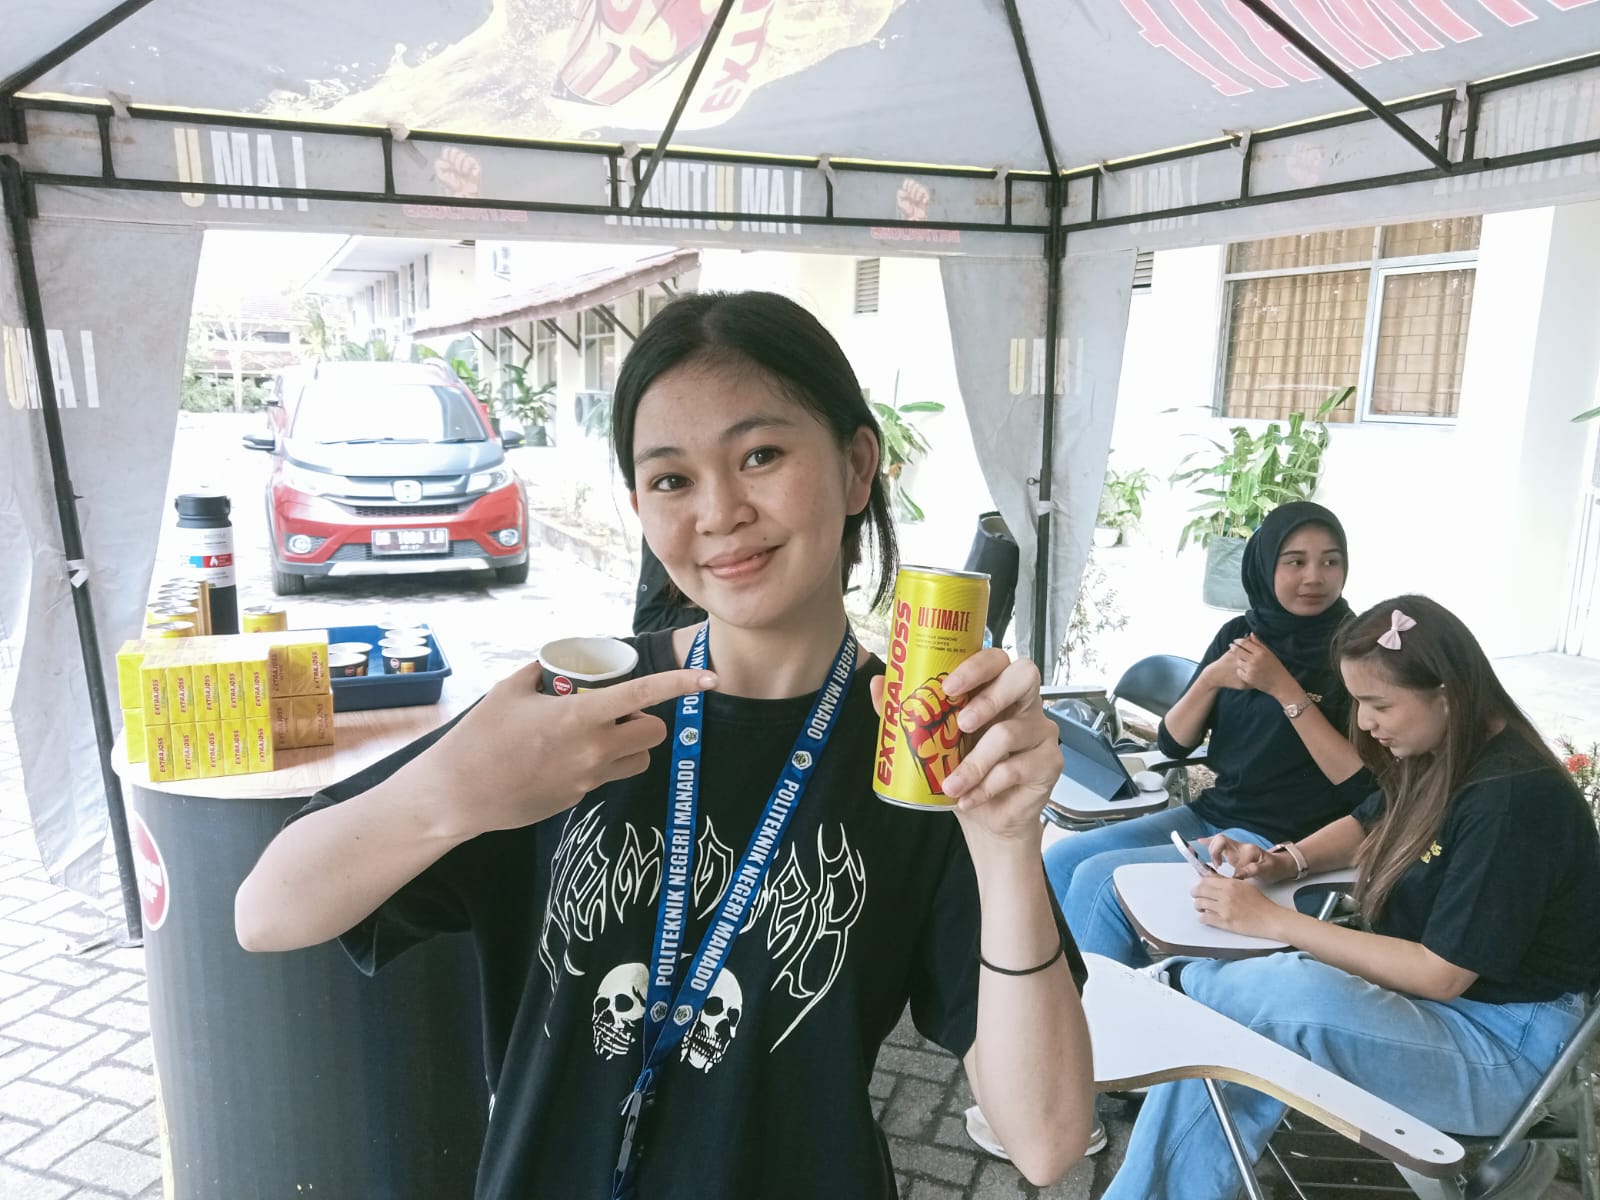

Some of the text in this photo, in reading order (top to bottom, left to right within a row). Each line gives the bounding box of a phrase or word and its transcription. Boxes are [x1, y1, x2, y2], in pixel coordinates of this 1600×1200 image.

[917, 606, 971, 633] ULTIMATE
[178, 677, 187, 713] EXTRAJOSS
[204, 674, 213, 711] EXTRAJOSS
[229, 672, 237, 709] EXTRAJOSS
[254, 671, 262, 707] EXTRAJOSS
[682, 642, 705, 714] POKNIK
[807, 638, 856, 740] NEGERI MANADO
[877, 599, 912, 786] EXTRAJOSS
[152, 679, 161, 715] EXTRAJOSS
[157, 737, 166, 773] EXTRAJOSS
[183, 735, 192, 770] EXTRAJOSS
[208, 732, 217, 768] EXTRAJOSS
[233, 730, 241, 765] EXTRAJOSS
[257, 727, 265, 763] EXTRAJOSS
[655, 759, 696, 986] POLITEKNIK NEGERI MANADO
[690, 779, 800, 992] POLITEKNIK NEGERI MANADO
